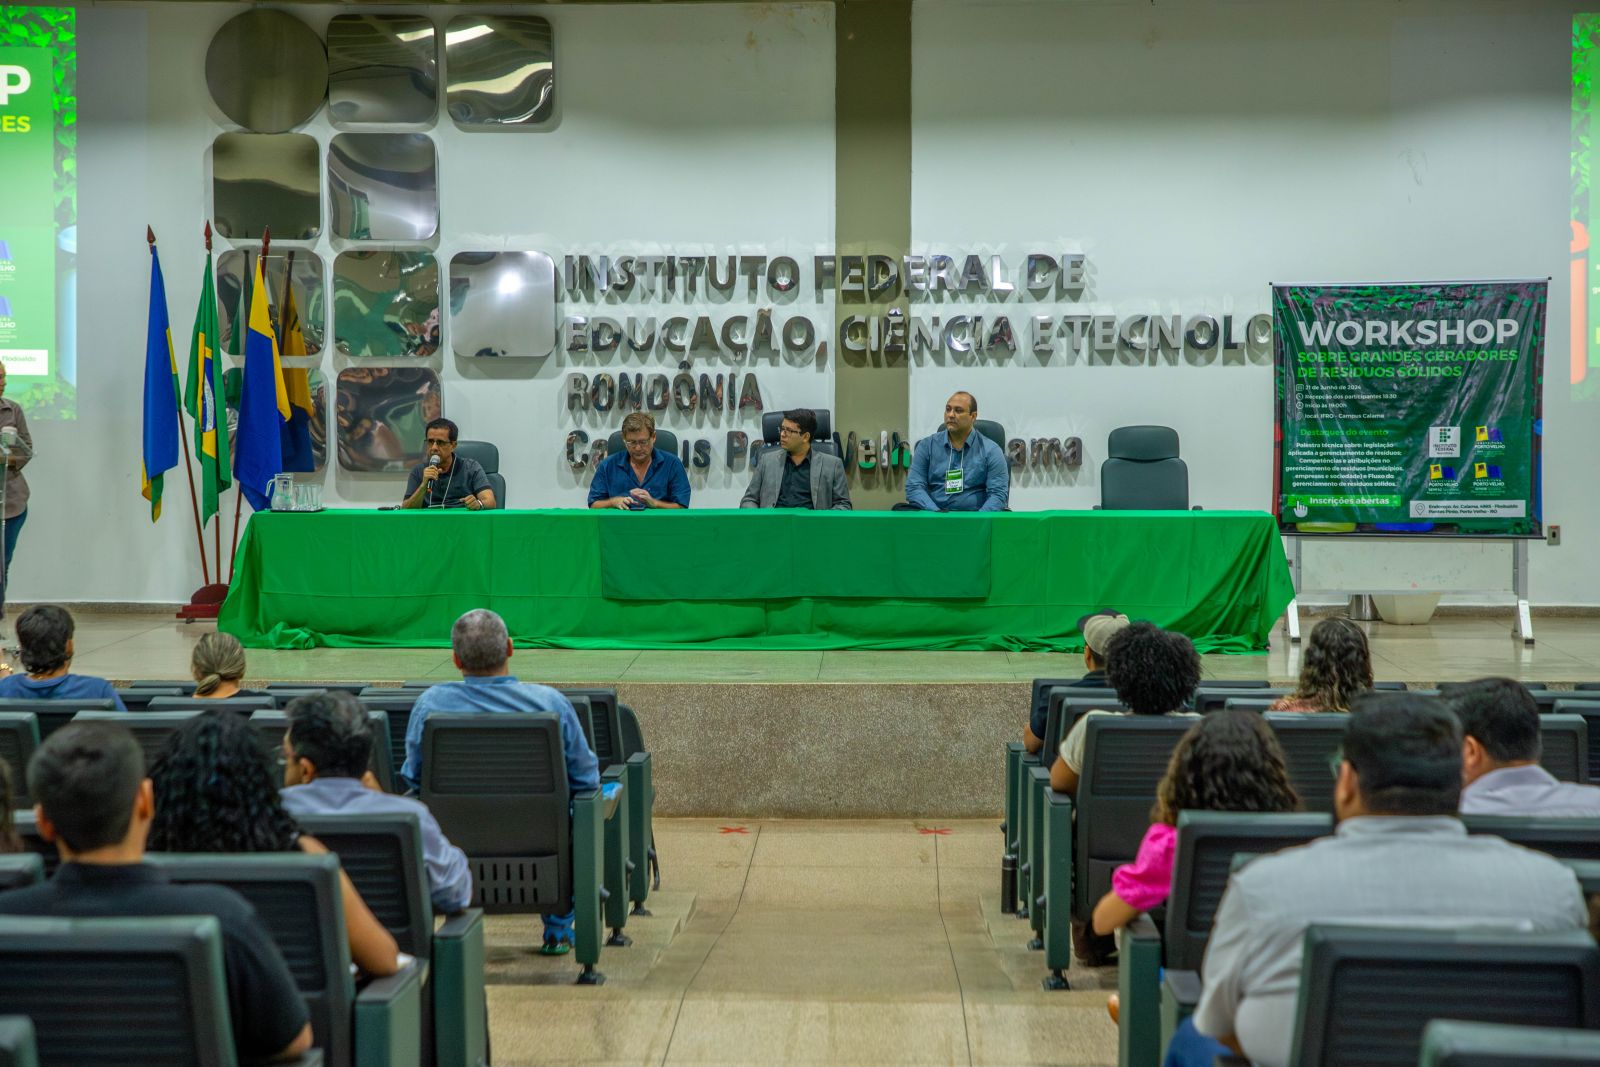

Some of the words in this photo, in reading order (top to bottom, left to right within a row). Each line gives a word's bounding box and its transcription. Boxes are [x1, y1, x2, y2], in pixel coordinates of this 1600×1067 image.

[565, 255, 800, 291] INSTITUTO
[814, 255, 1014, 291] FEDERAL
[1028, 255, 1085, 291] DE
[566, 308, 828, 361] EDUCAÇÃO,
[840, 308, 1016, 351] CIÊNCIA
[1032, 314, 1054, 350] E
[1298, 319, 1519, 346] WORKSHOP
[1298, 351, 1347, 363] SOBRE
[1350, 350, 1421, 362] GRANDES
[1425, 349, 1518, 362] GERADORES
[1298, 366, 1317, 378] DE
[1320, 364, 1394, 378] RESÍDUOS
[1397, 363, 1462, 378] SÓLIDOS
[567, 361, 763, 412] RONDÔNIA
[1301, 429, 1341, 437] Destaques
[832, 430, 912, 470] Velh
[1310, 497, 1354, 506] Inscrições
[1355, 497, 1390, 505] abertas
